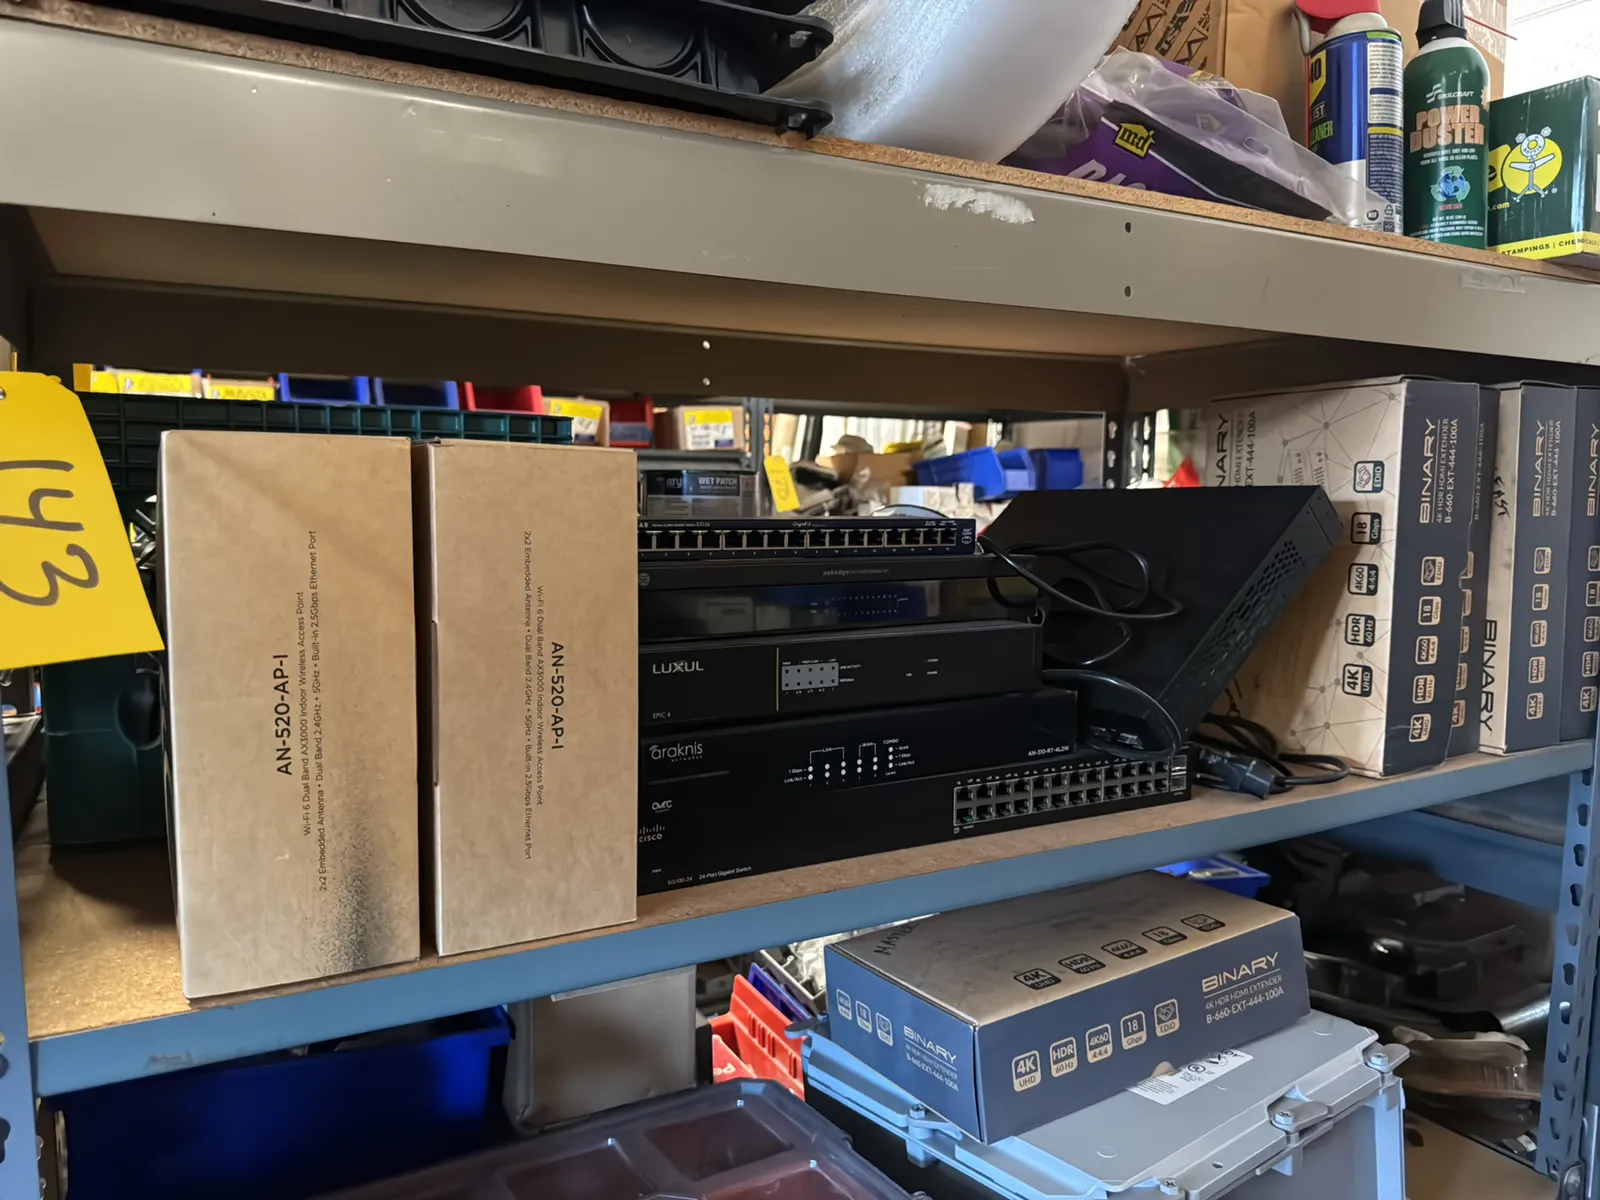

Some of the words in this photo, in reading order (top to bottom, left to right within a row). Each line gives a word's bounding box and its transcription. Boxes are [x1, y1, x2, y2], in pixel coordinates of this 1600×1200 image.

[1437, 90, 1475, 100] SKILCRAFT
[1416, 104, 1480, 131] POWER
[1410, 123, 1485, 153] DUSTER
[1489, 201, 1511, 211] .com
[1501, 242, 1550, 256] STAMPINGS
[1215, 413, 1229, 487] NARY
[1245, 411, 1256, 487] EXT-444-100A
[1440, 418, 1448, 464] EXTENDER
[1374, 467, 1382, 487] EDID
[1419, 417, 1436, 524] BINARY
[1438, 465, 1446, 490] HDMI
[1444, 418, 1458, 523] B-660-EXT-444-100A
[1533, 420, 1544, 517] BINARY
[1587, 423, 1600, 516] BINARY
[698, 476, 715, 485] WET
[1372, 518, 1381, 539] Gbps
[1436, 512, 1443, 524] 4K
[0, 459, 99, 607] 143
[524, 530, 532, 546] 2x2
[1357, 522, 1367, 536] 18
[310, 552, 318, 590] Ethernet
[1356, 567, 1365, 591] 4K60
[1536, 592, 1542, 603] 18
[311, 592, 320, 628] 2.5Gbps
[1423, 606, 1432, 617] 18
[298, 617, 306, 647] Access
[1351, 617, 1360, 642] HDR
[1366, 619, 1374, 631] Hz
[313, 630, 321, 661] Built-in
[1365, 631, 1373, 643] 60
[1421, 639, 1429, 660] 4K60
[299, 649, 307, 686] Wireless
[652, 660, 705, 675] LUXUL
[1480, 619, 1498, 732] BINARY
[1347, 669, 1359, 690] 4K
[1363, 672, 1371, 691] UHD
[1417, 678, 1425, 700] HDR
[524, 677, 532, 706] 2.4GHz
[551, 641, 564, 750] AN-520-AP-I
[1582, 691, 1590, 708] 4K
[300, 688, 308, 717] Indoor
[1529, 697, 1537, 716] 4K
[273, 654, 292, 776] AN-520-AP-I
[314, 704, 323, 735] 2.4GHz
[652, 711, 666, 719] EPIC
[301, 719, 309, 756] AX3000
[1413, 719, 1423, 738] 4K
[315, 738, 323, 760] Band
[650, 741, 703, 760] araknis
[302, 758, 310, 780] Band
[316, 762, 324, 781] Dual
[302, 783, 310, 801] Dual
[524, 774, 532, 806] 2.5Gbps
[304, 813, 312, 836] Wi-Fi
[319, 828, 327, 874] Embedded
[698, 871, 718, 880] 24-Port
[717, 868, 736, 877] Gigabit
[735, 865, 752, 874] Switch
[320, 876, 328, 891] 2x2
[1152, 929, 1168, 938] 18
[1064, 956, 1093, 968] HDR
[1202, 952, 1279, 992] BINARY
[1022, 970, 1047, 982] 4K
[1035, 977, 1055, 988] UHD
[1205, 1002, 1214, 1010] 4K
[1214, 995, 1230, 1007] HDR
[1230, 988, 1250, 1000] HDMI
[1249, 974, 1282, 994] EXTENDER
[1206, 986, 1285, 1024] B-660-EXT-444-100A
[1127, 1019, 1139, 1033] 18
[1160, 1022, 1176, 1034] EDID
[904, 1025, 957, 1065] BINARY
[1089, 1032, 1109, 1047] 4K60
[1126, 1035, 1143, 1047] Gbps
[1052, 1044, 1074, 1061] HDR
[1016, 1059, 1037, 1074] 4K
[1055, 1064, 1066, 1074] 60
[1065, 1061, 1074, 1071] Hz
[1018, 1076, 1037, 1088] UHD
